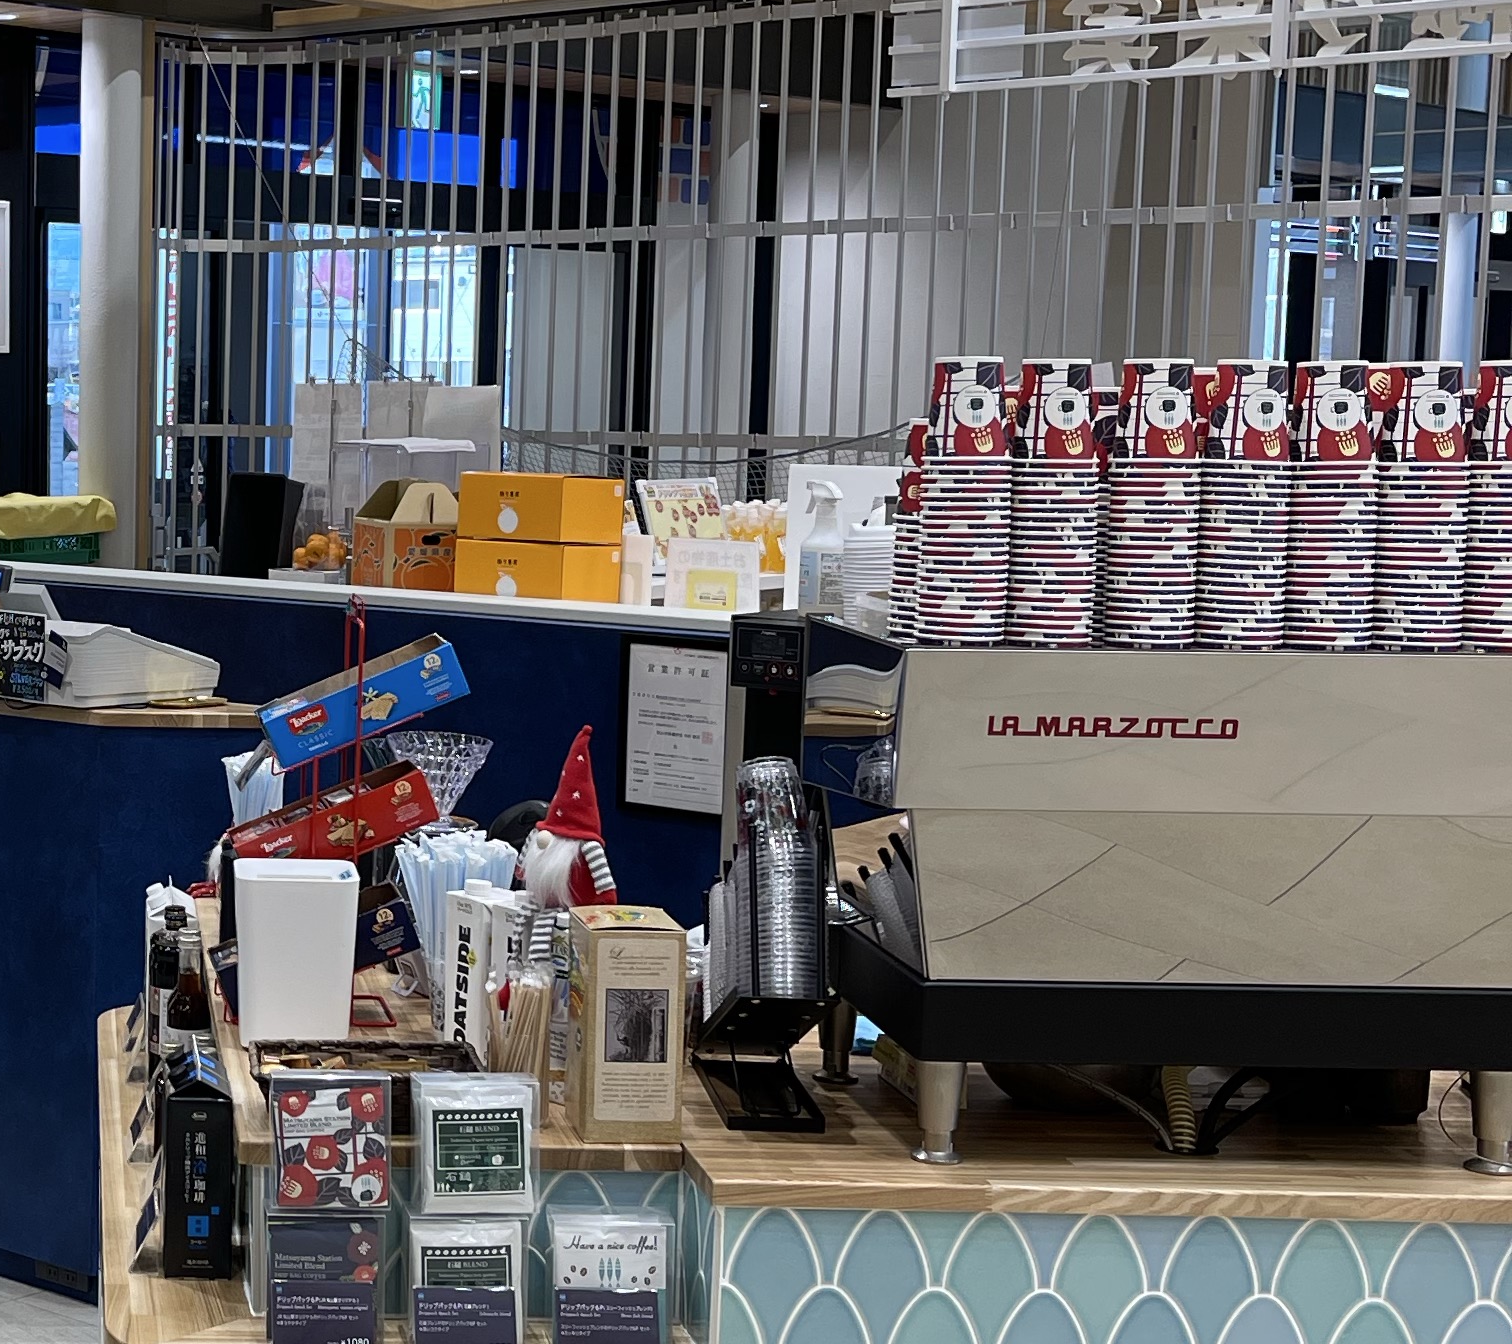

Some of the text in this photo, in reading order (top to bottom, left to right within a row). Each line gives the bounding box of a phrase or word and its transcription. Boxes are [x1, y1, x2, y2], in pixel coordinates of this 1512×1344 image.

[289, 707, 322, 728] Loacker
[986, 714, 1240, 740] LA MARZOCCO
[297, 728, 333, 749] CLASSIC
[260, 835, 293, 853] Loacker
[563, 1235, 594, 1250] Have
[607, 1241, 625, 1250] nice
[627, 1235, 658, 1254] coffee!
[274, 1253, 343, 1262] Matsuyama Station
[274, 1261, 326, 1270] Limited Blend
[463, 1260, 489, 1268] BLEND
